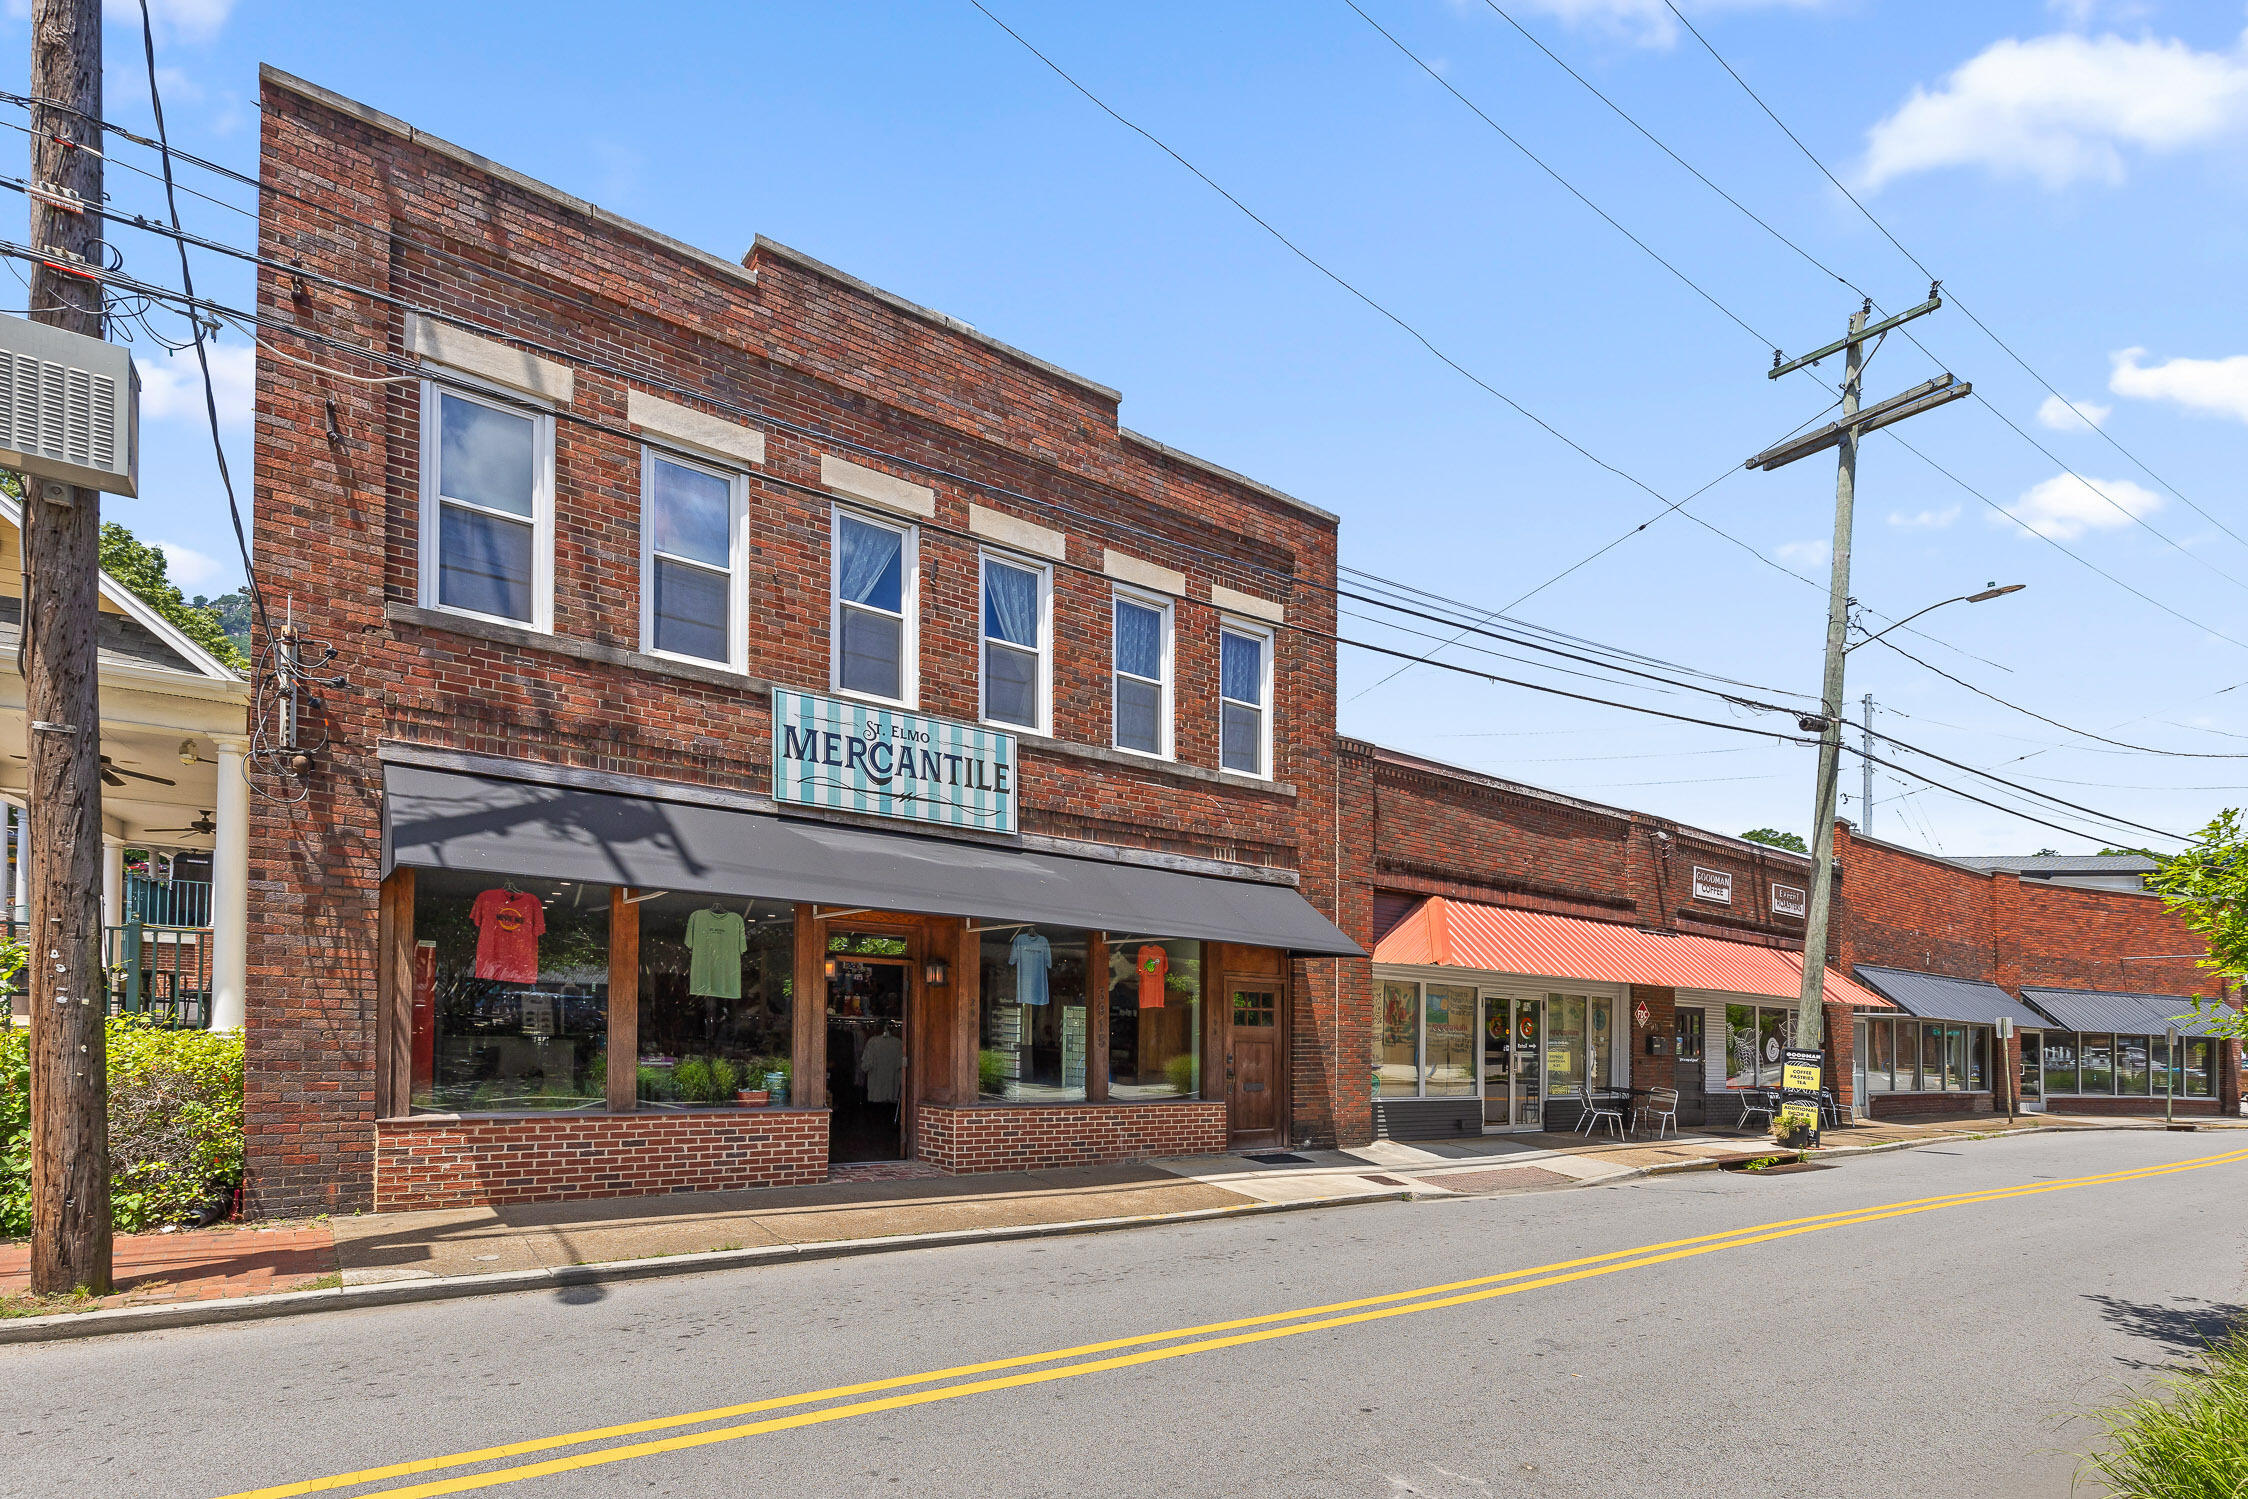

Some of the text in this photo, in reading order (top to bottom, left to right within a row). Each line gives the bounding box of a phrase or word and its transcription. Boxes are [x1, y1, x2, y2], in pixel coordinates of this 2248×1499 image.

[891, 725, 931, 744] ELMO
[783, 724, 1011, 795] MERCANTILE
[1697, 872, 1730, 886] GOODMAN
[1701, 883, 1724, 896] COFFEE
